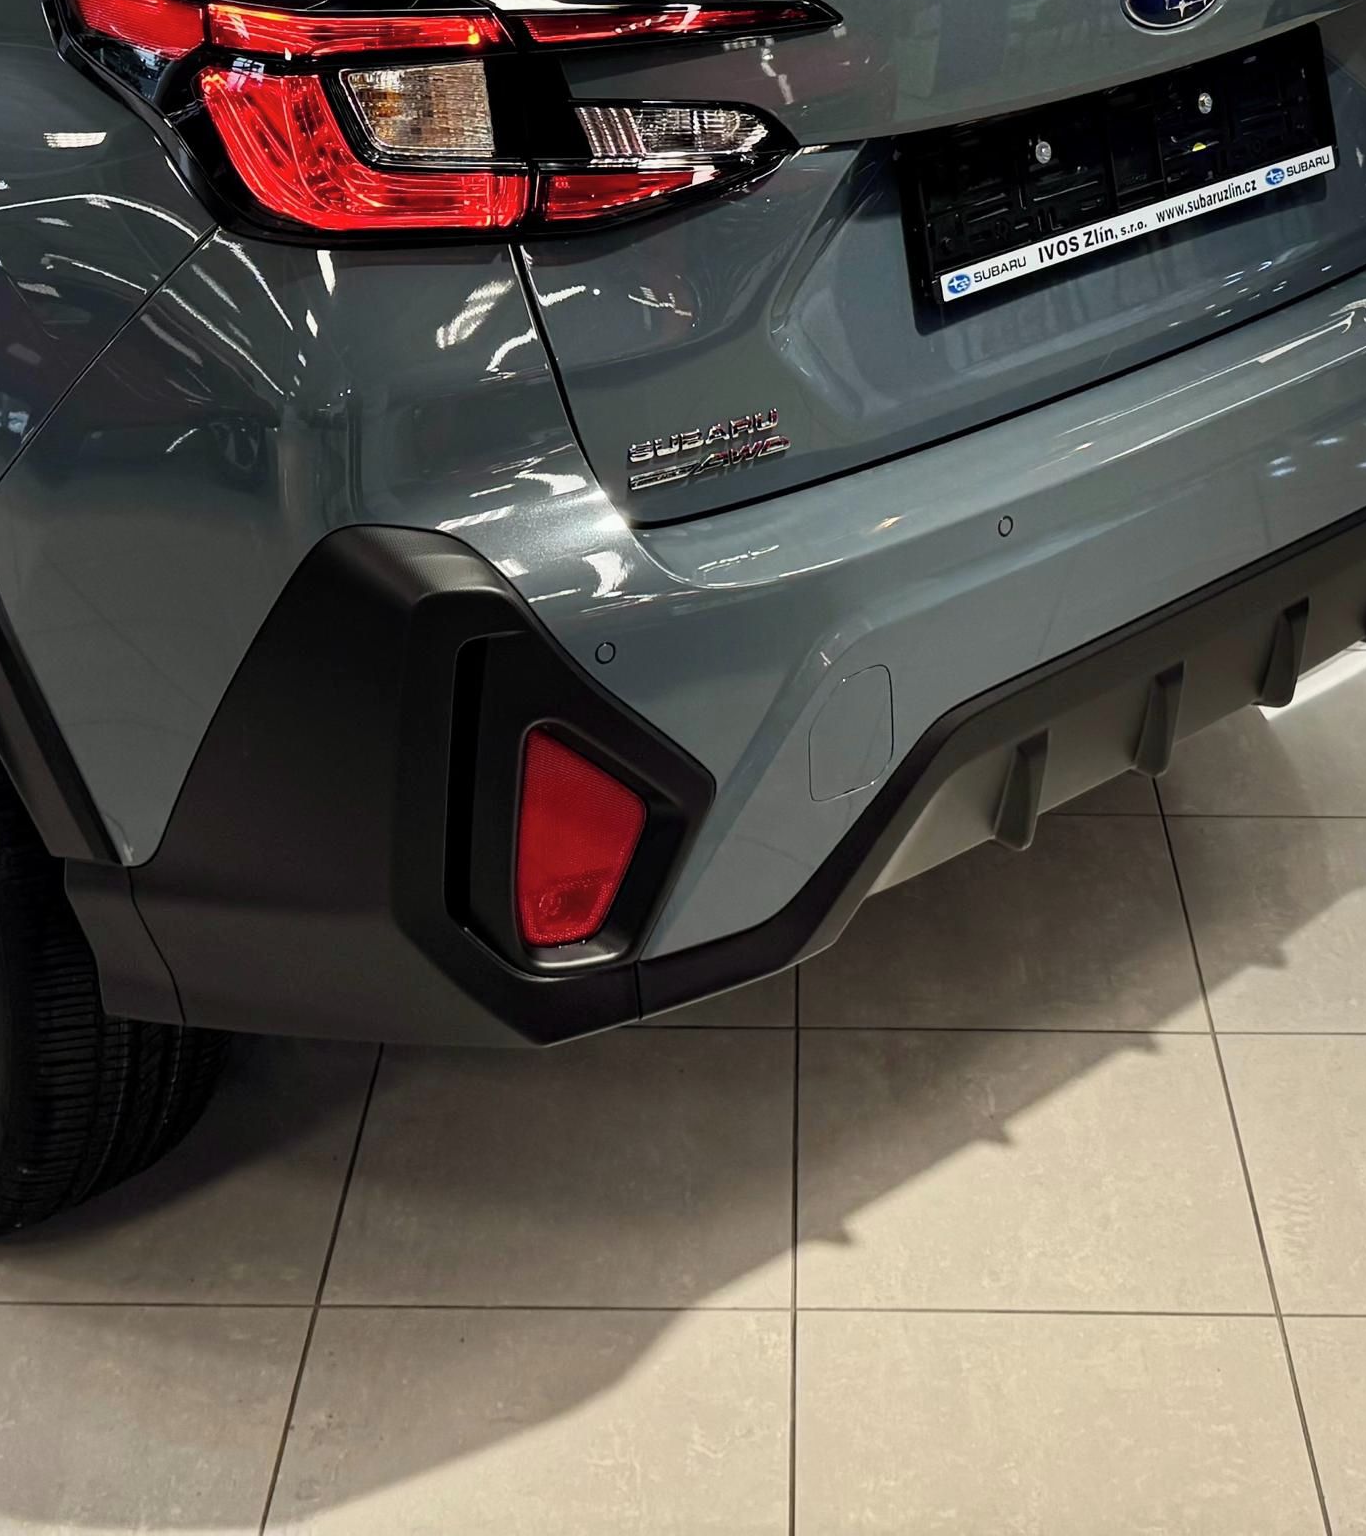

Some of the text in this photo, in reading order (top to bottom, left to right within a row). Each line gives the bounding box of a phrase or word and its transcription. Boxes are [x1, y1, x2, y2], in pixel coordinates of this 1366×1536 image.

[973, 154, 1330, 283] SUBARU IVOS Zlín, s.r.o. www.subaruzlin.cz SUBARU
[628, 407, 779, 463] SUBARU
[694, 435, 792, 475] AWD
